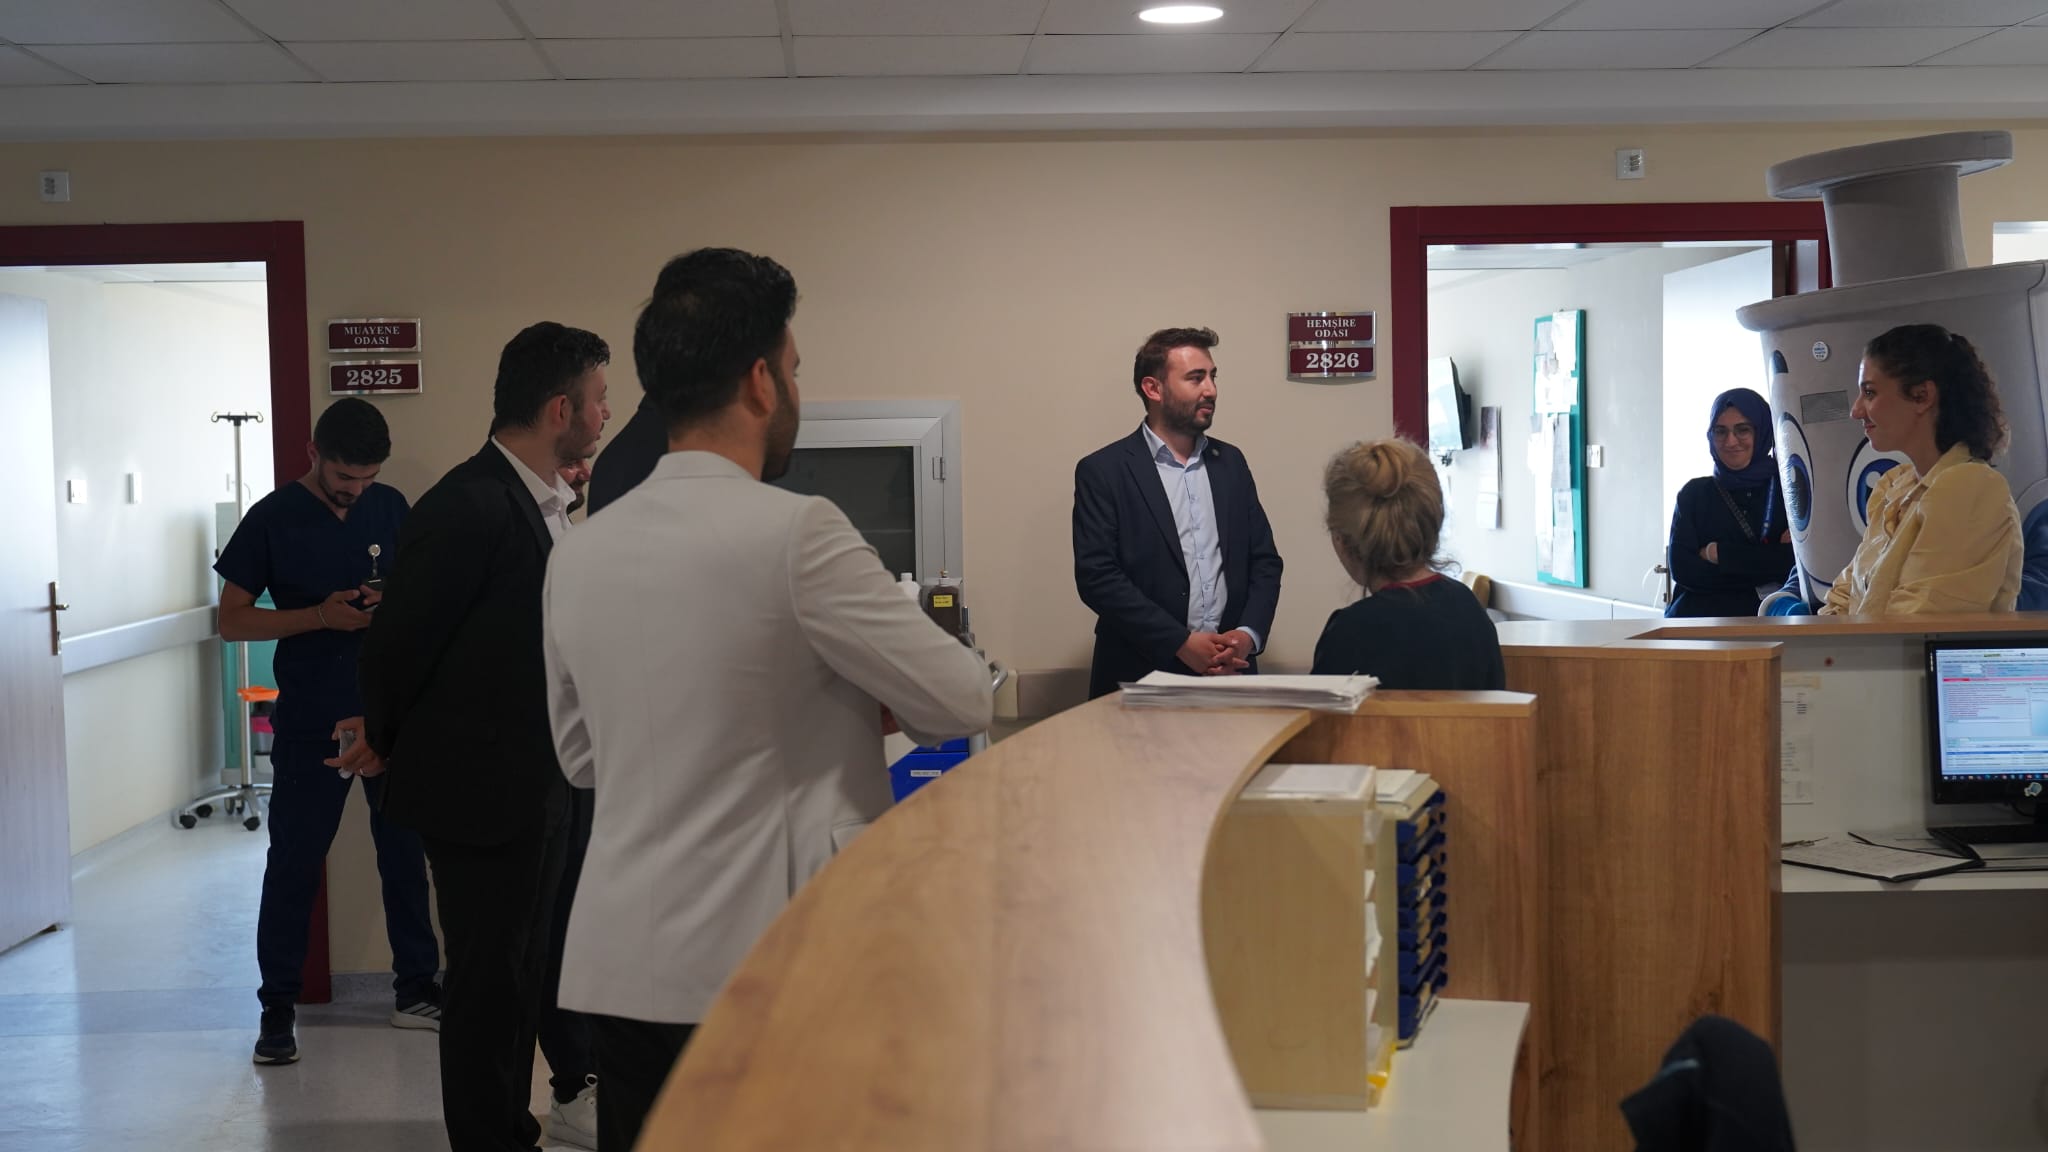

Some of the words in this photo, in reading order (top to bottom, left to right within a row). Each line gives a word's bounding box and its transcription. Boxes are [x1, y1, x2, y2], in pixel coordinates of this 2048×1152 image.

[1306, 318, 1357, 329] HEMŞİRE
[344, 326, 400, 336] MUAYENE
[1314, 329, 1348, 338] ODASI
[354, 336, 390, 345] ODASI
[1306, 352, 1360, 369] 2826
[346, 368, 402, 386] 2825
